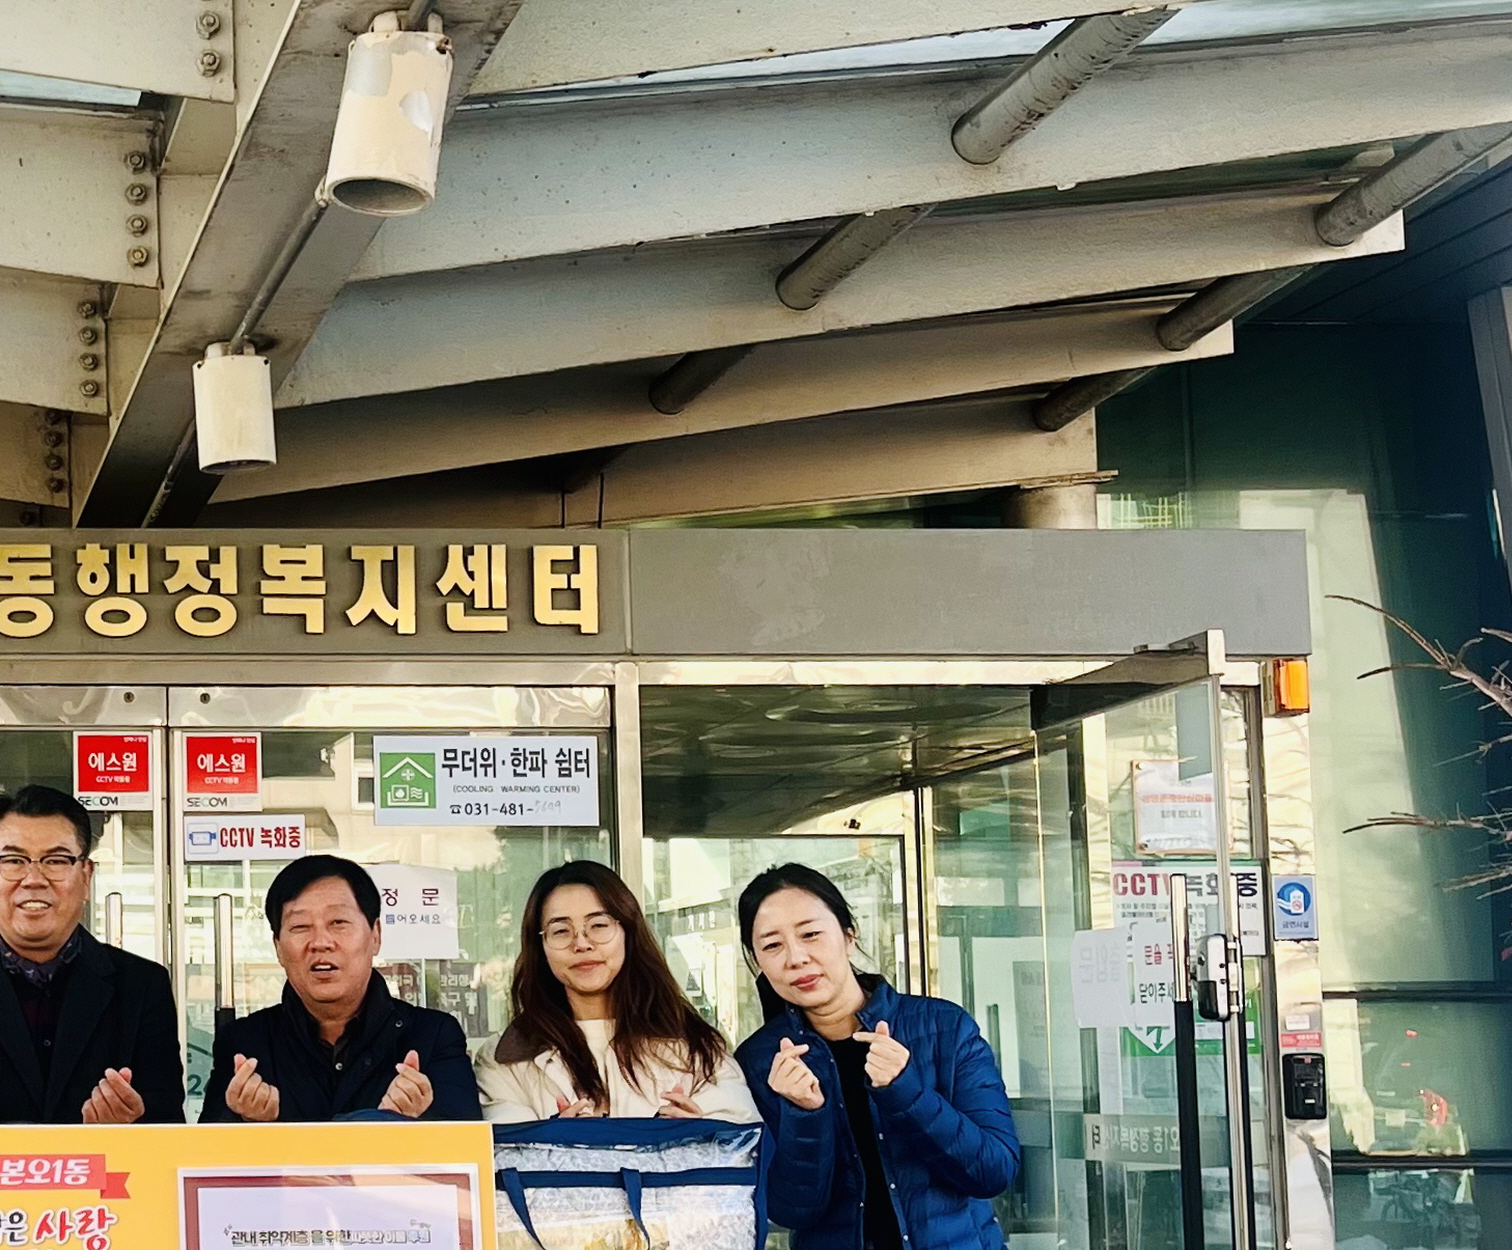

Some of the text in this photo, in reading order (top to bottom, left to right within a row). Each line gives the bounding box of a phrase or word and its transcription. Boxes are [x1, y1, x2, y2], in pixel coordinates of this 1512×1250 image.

[88, 752, 138, 772] 에스원
[197, 753, 246, 773] 에스원
[554, 747, 591, 778] 쉼터
[500, 785, 541, 793] WARMING
[78, 796, 119, 807] SECOM
[186, 797, 228, 808] SECOM
[220, 826, 301, 849] CCTV 녹화중
